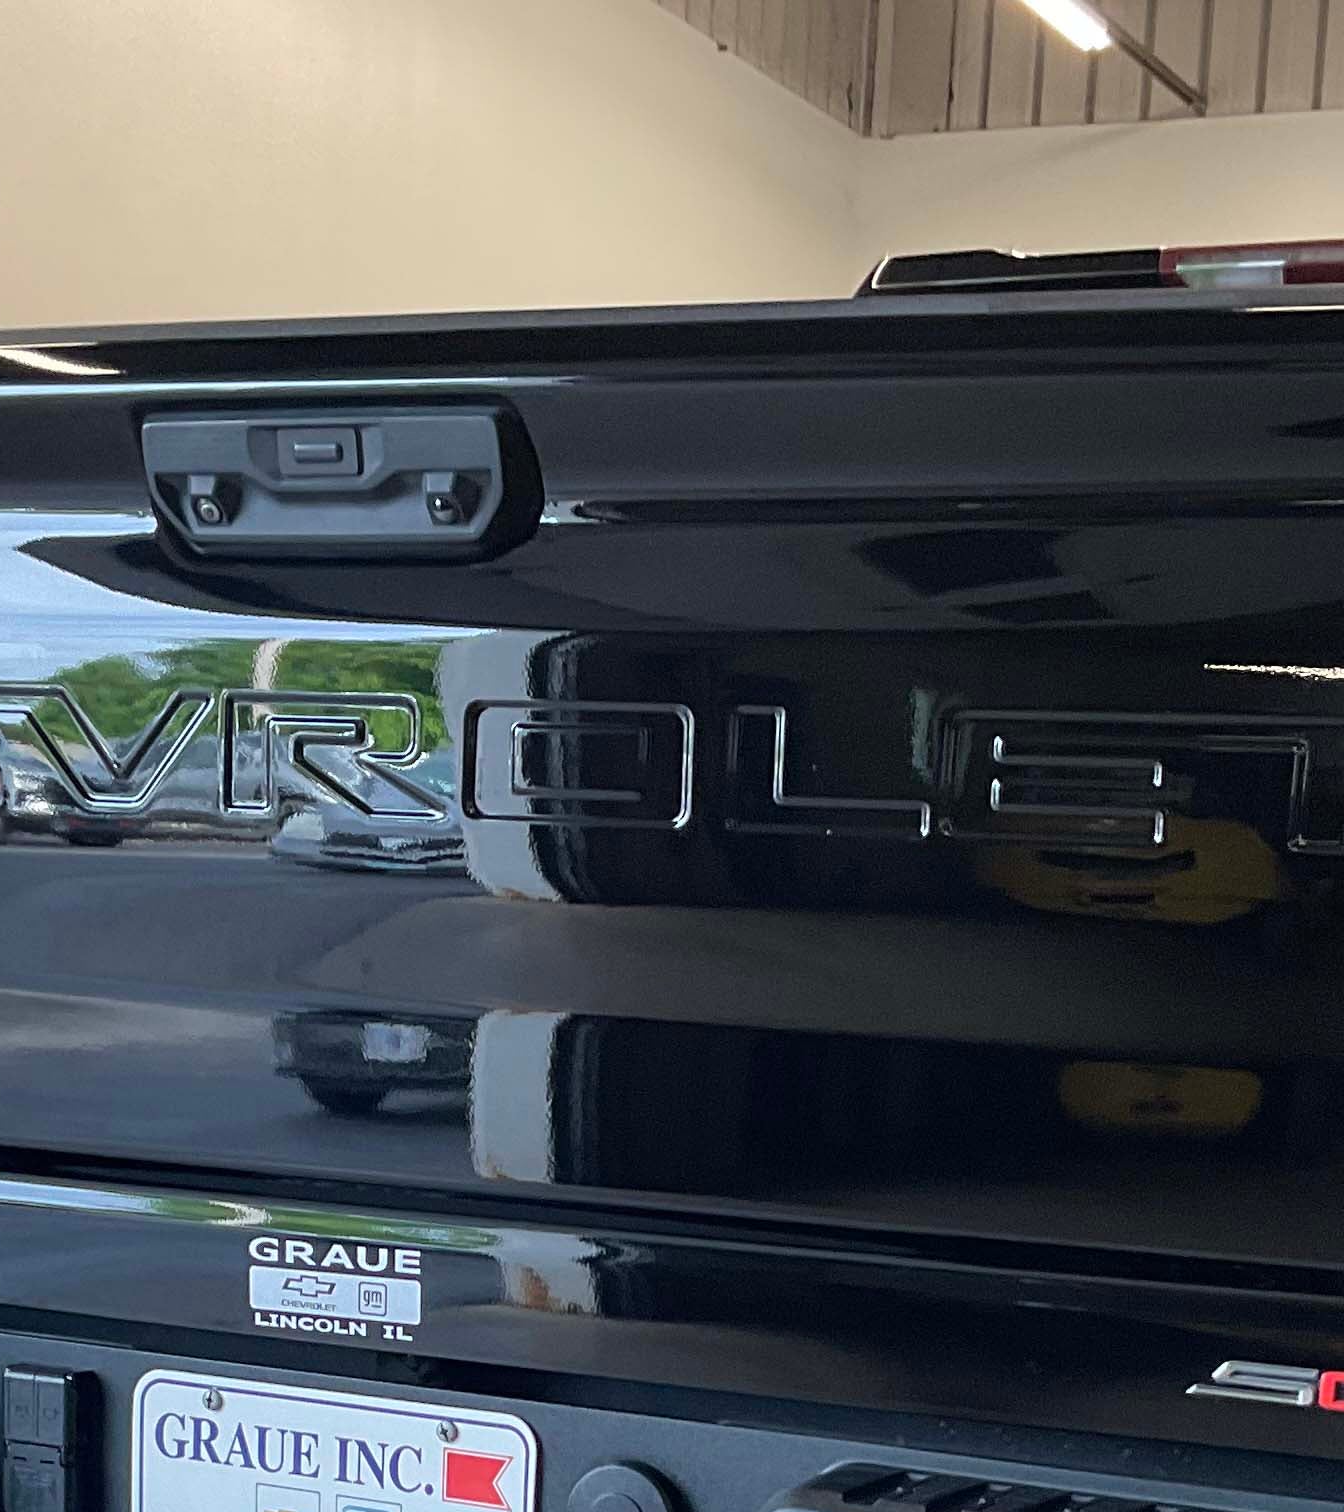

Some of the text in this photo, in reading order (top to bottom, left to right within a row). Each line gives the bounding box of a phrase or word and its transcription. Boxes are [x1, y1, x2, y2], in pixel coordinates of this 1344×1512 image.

[248, 1236, 422, 1275] GRAUE
[280, 1298, 337, 1313] CHEVROLET
[362, 1289, 383, 1308] gm
[254, 1312, 414, 1342] LINCOLN IL
[155, 1412, 435, 1496] GRAUE INC.
